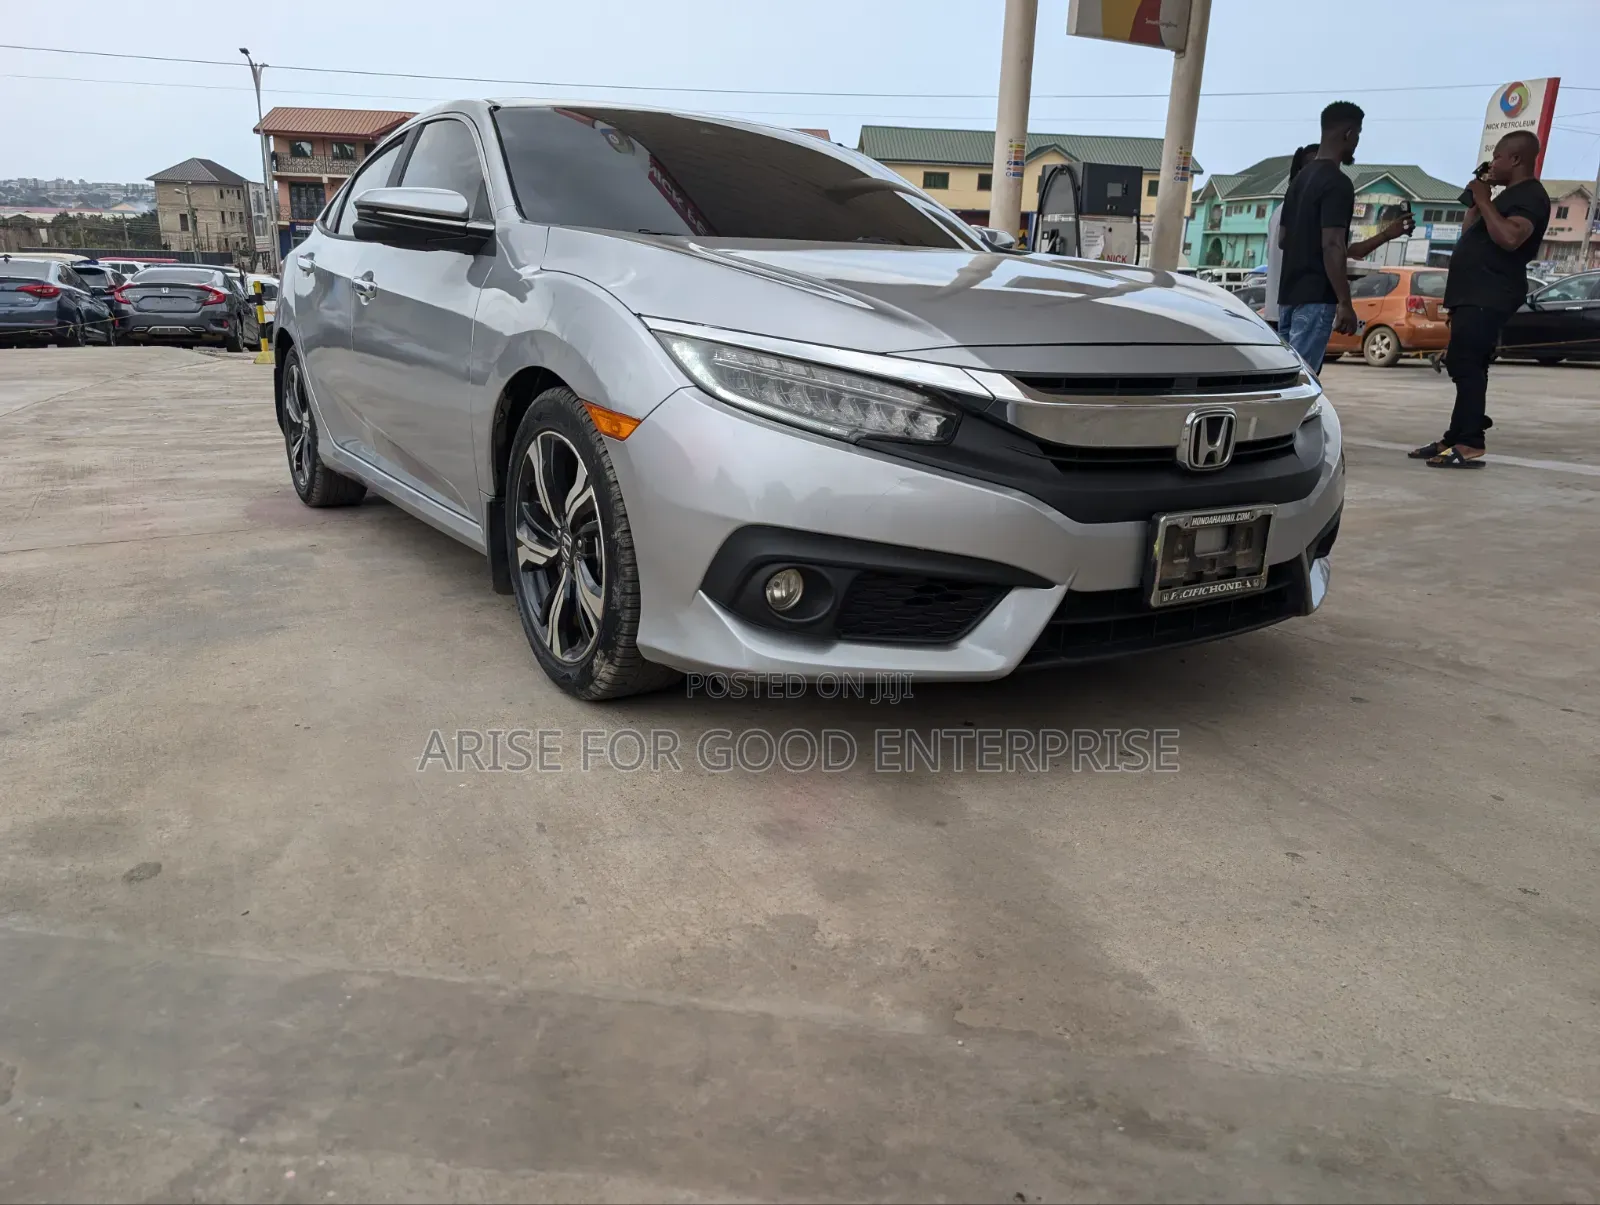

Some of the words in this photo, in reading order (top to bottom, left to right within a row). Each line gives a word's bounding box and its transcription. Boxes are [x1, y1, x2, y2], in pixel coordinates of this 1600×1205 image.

[1485, 122, 1500, 131] NICK
[1500, 119, 1536, 129] PETROLEUM
[1106, 255, 1127, 264] NICK
